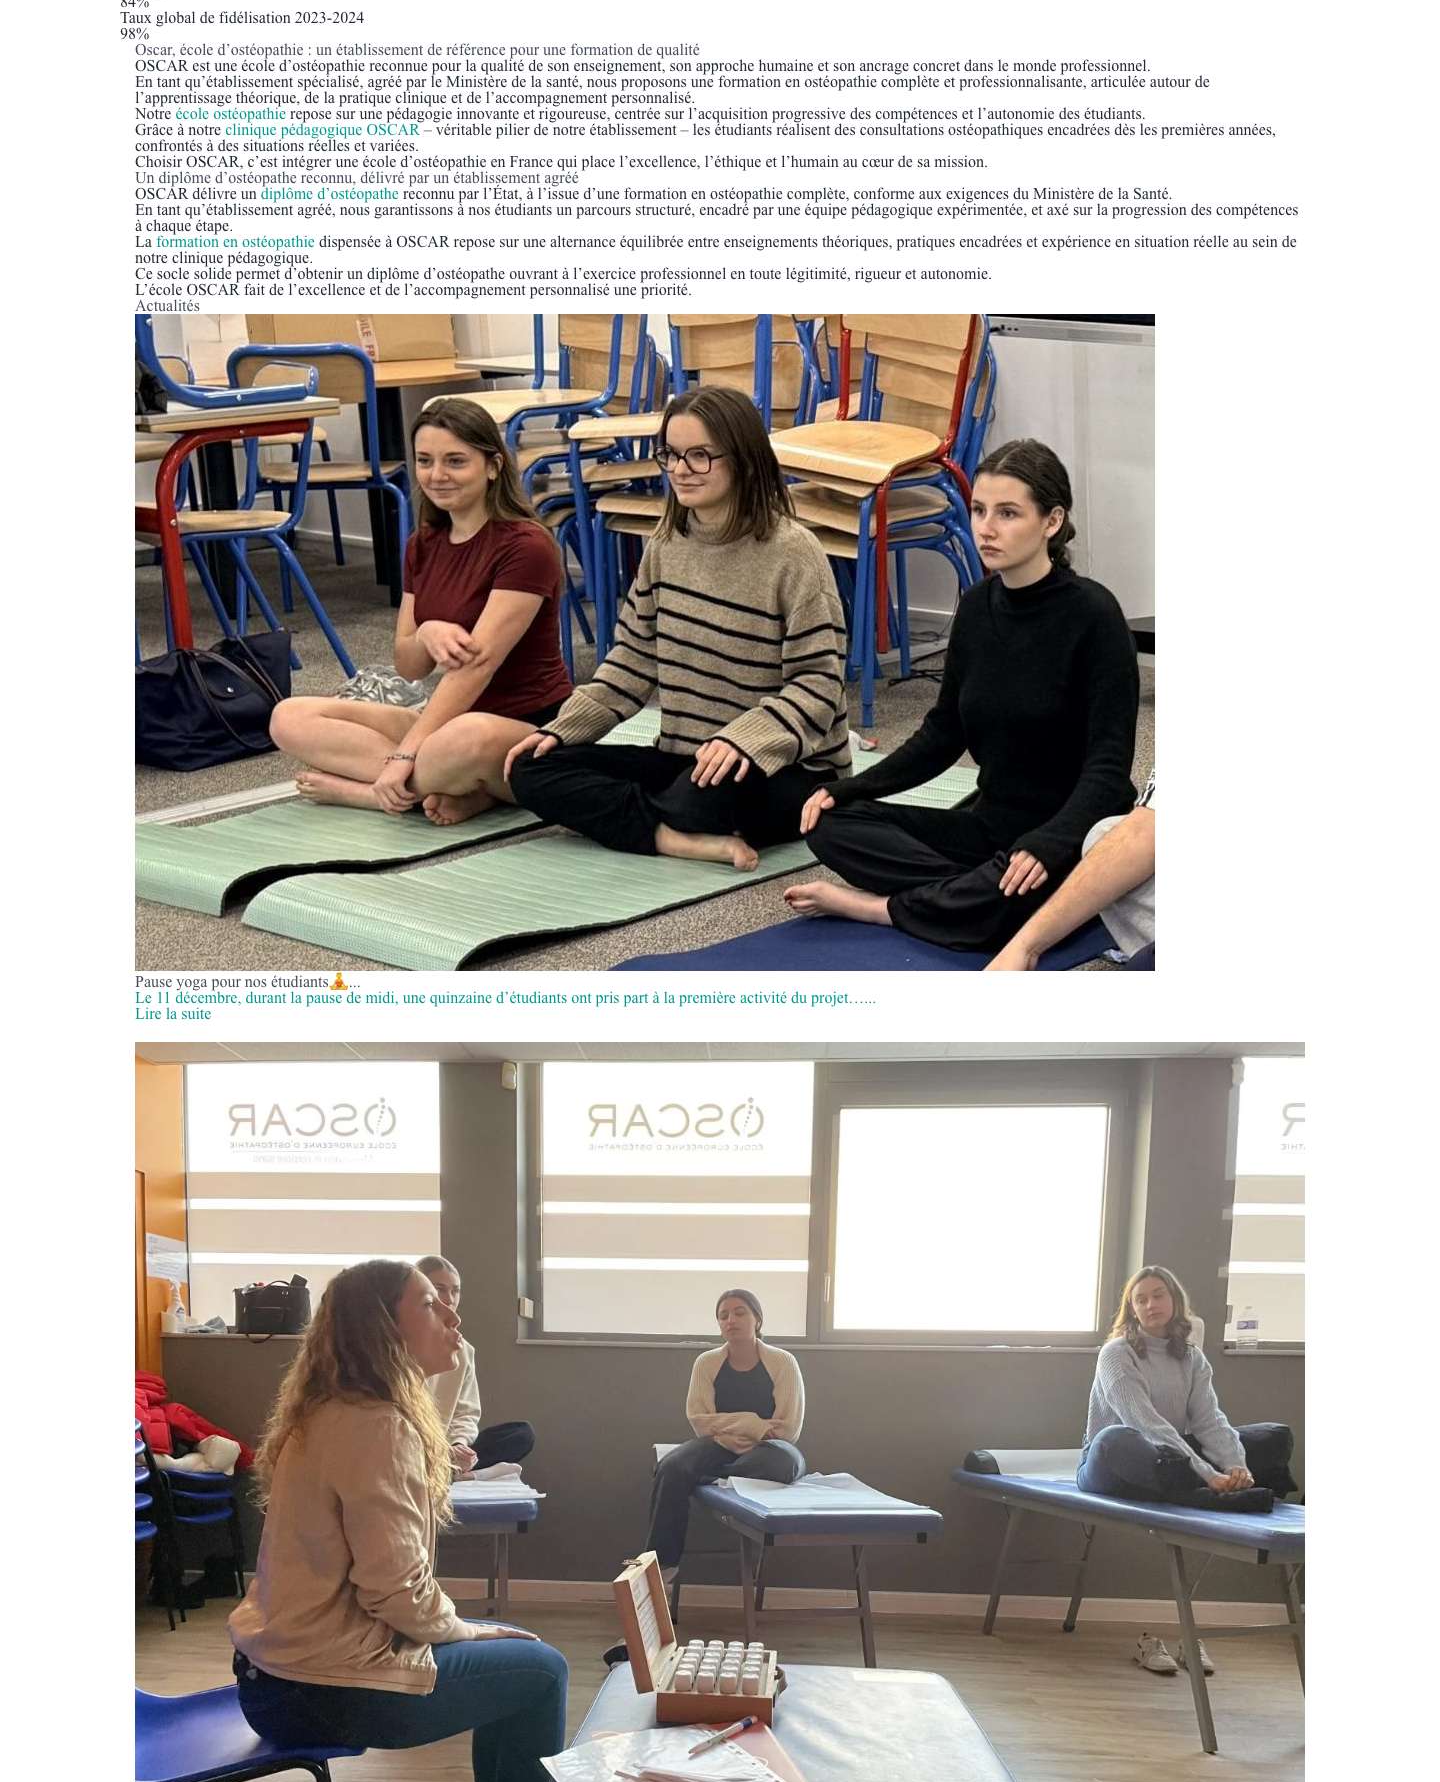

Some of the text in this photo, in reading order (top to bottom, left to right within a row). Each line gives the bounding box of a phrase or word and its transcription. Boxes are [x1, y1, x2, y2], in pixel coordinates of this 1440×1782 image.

[134, 138, 419, 152] confrontés à des situations réelles et variées.
[135, 1006, 212, 1019] Lire la suite
